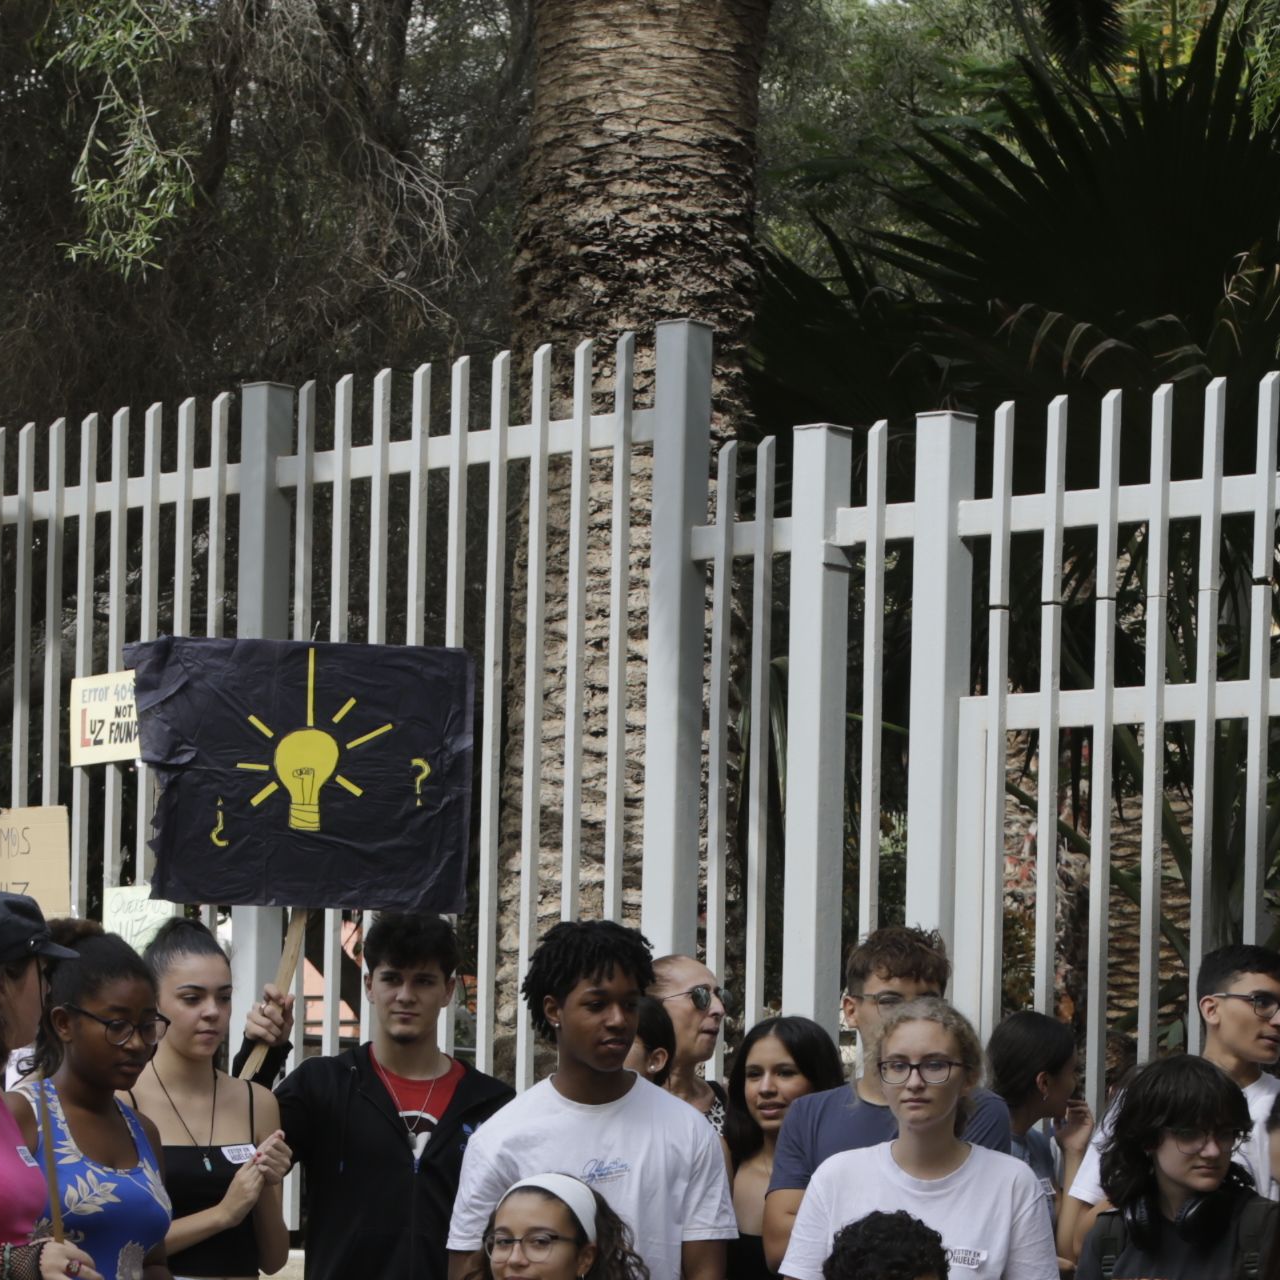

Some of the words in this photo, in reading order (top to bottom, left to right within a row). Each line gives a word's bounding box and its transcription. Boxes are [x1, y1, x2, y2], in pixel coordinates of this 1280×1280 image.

[114, 704, 134, 719] NOT
[80, 708, 105, 748] LUZ
[108, 716, 138, 745] FOUND
[953, 1248, 972, 1257] ESTOY
[952, 1255, 980, 1266] HUELGA
